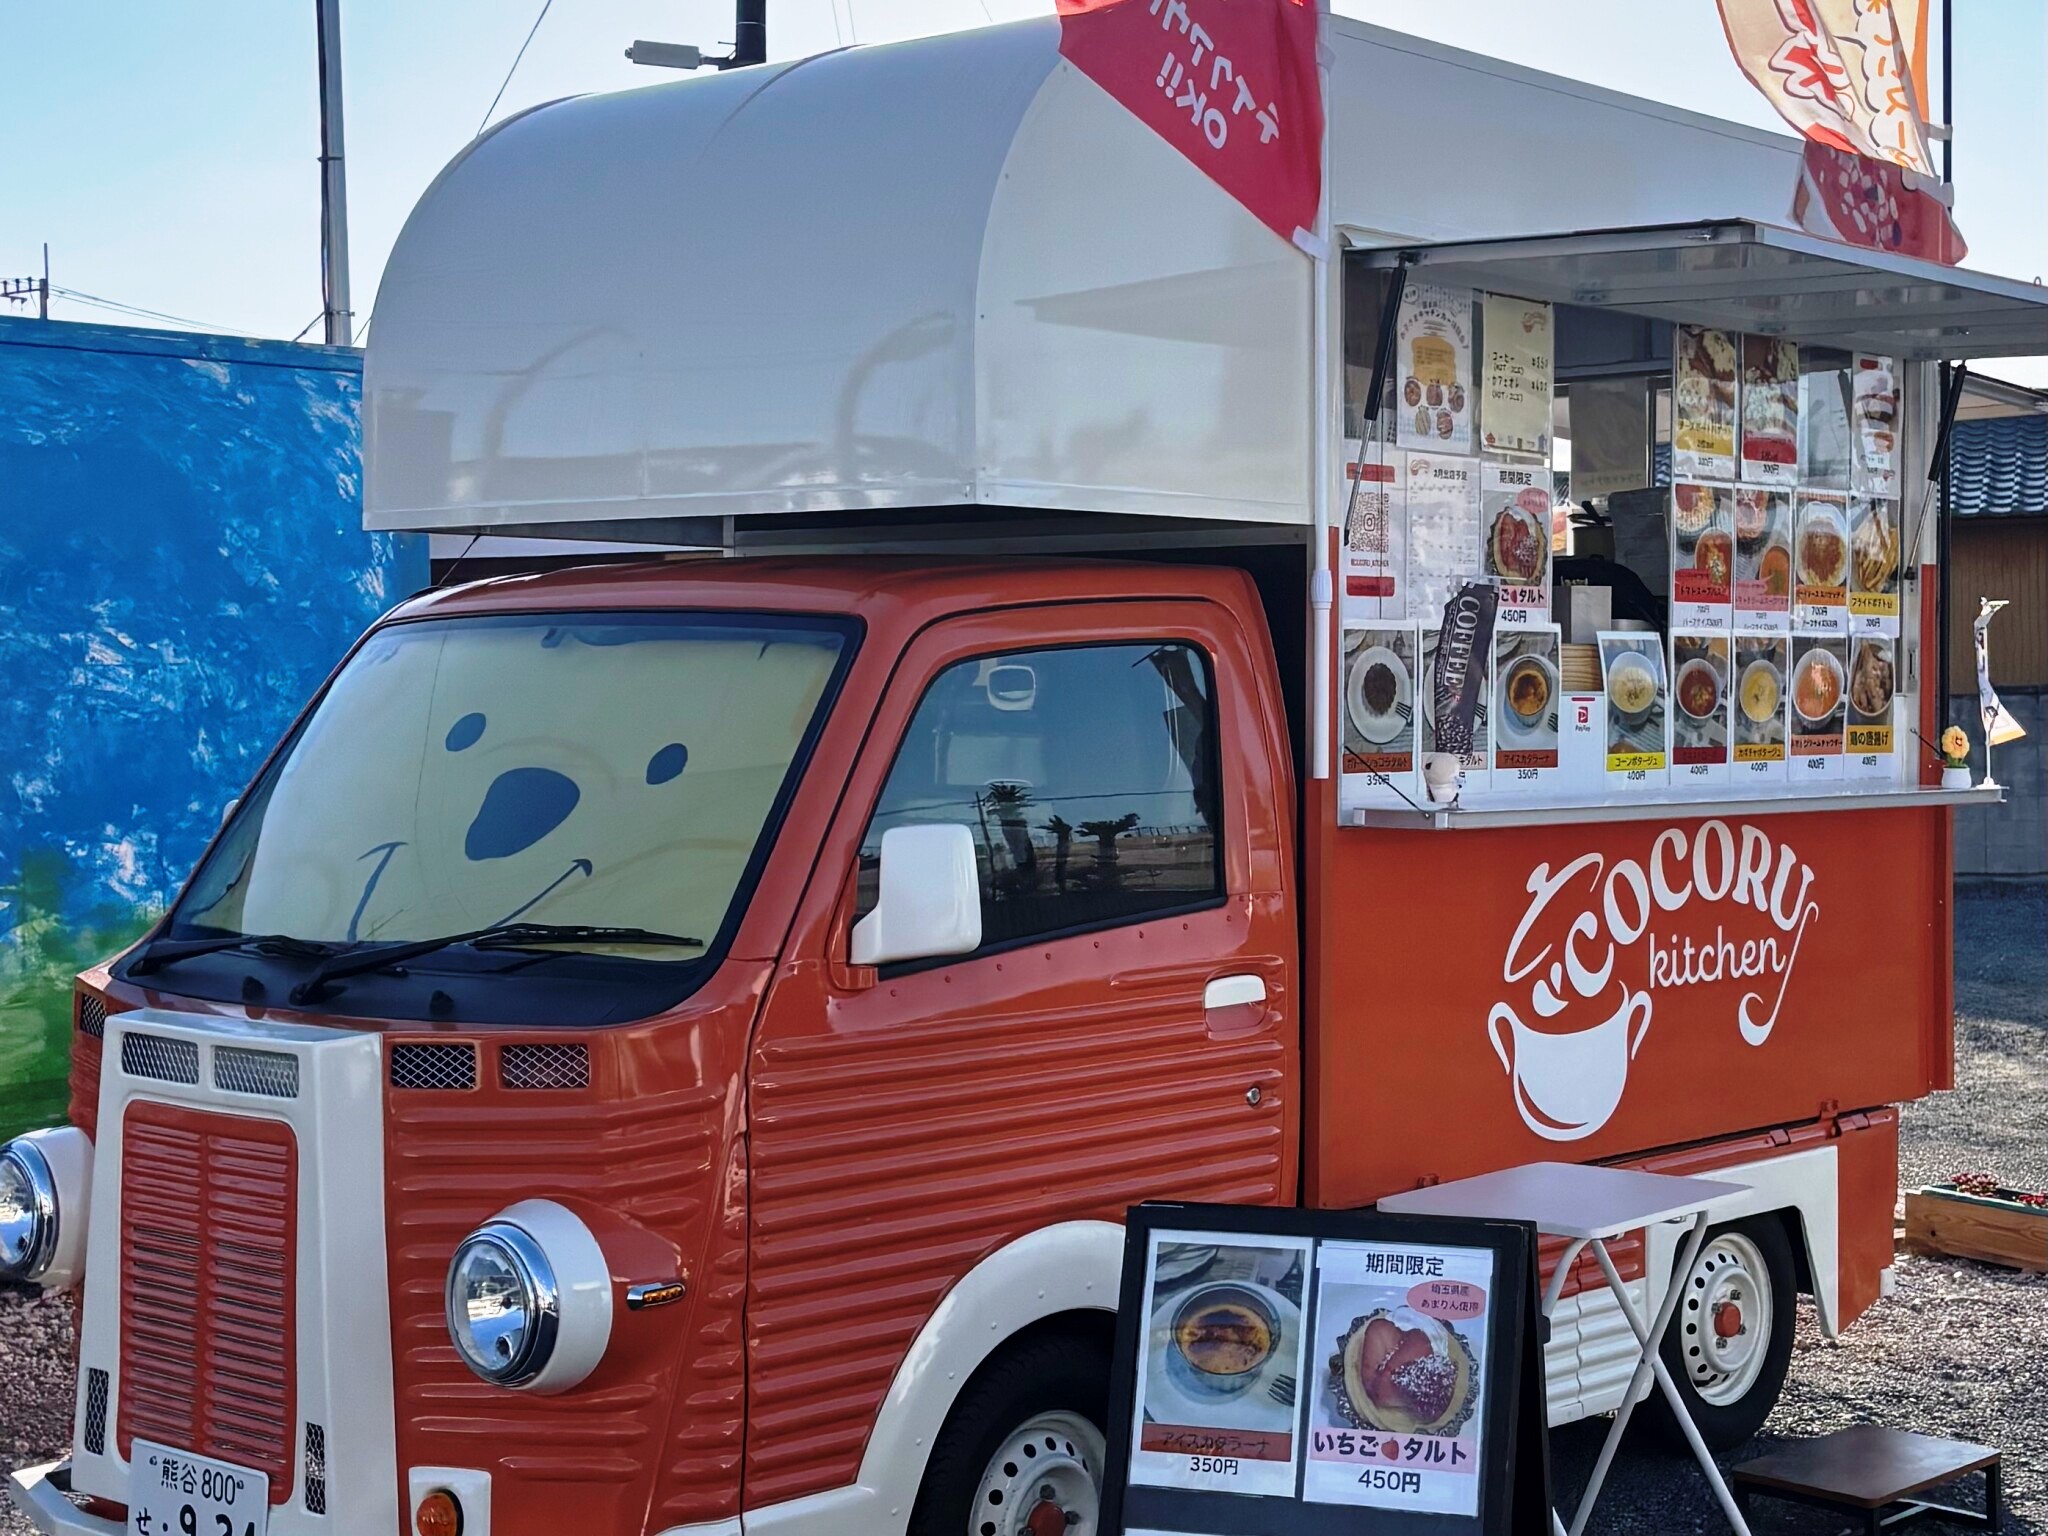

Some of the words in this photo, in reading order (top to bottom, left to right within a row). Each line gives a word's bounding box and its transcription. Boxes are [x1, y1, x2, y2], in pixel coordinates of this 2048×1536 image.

[1501, 609, 1527, 622] 450円
[1444, 596, 1480, 688] COFFEE
[1616, 755, 1658, 767] コーンポタージュ
[1517, 768, 1538, 780] 350円
[1565, 819, 1815, 998] COCORU
[1650, 925, 1787, 989] kitchen
[1365, 1252, 1444, 1277] 期間限定
[1421, 1299, 1479, 1312] あまりん使用
[1162, 1432, 1270, 1455] アイスカタラーナ
[1190, 1456, 1239, 1476] 350円
[1357, 1468, 1421, 1494] 450円
